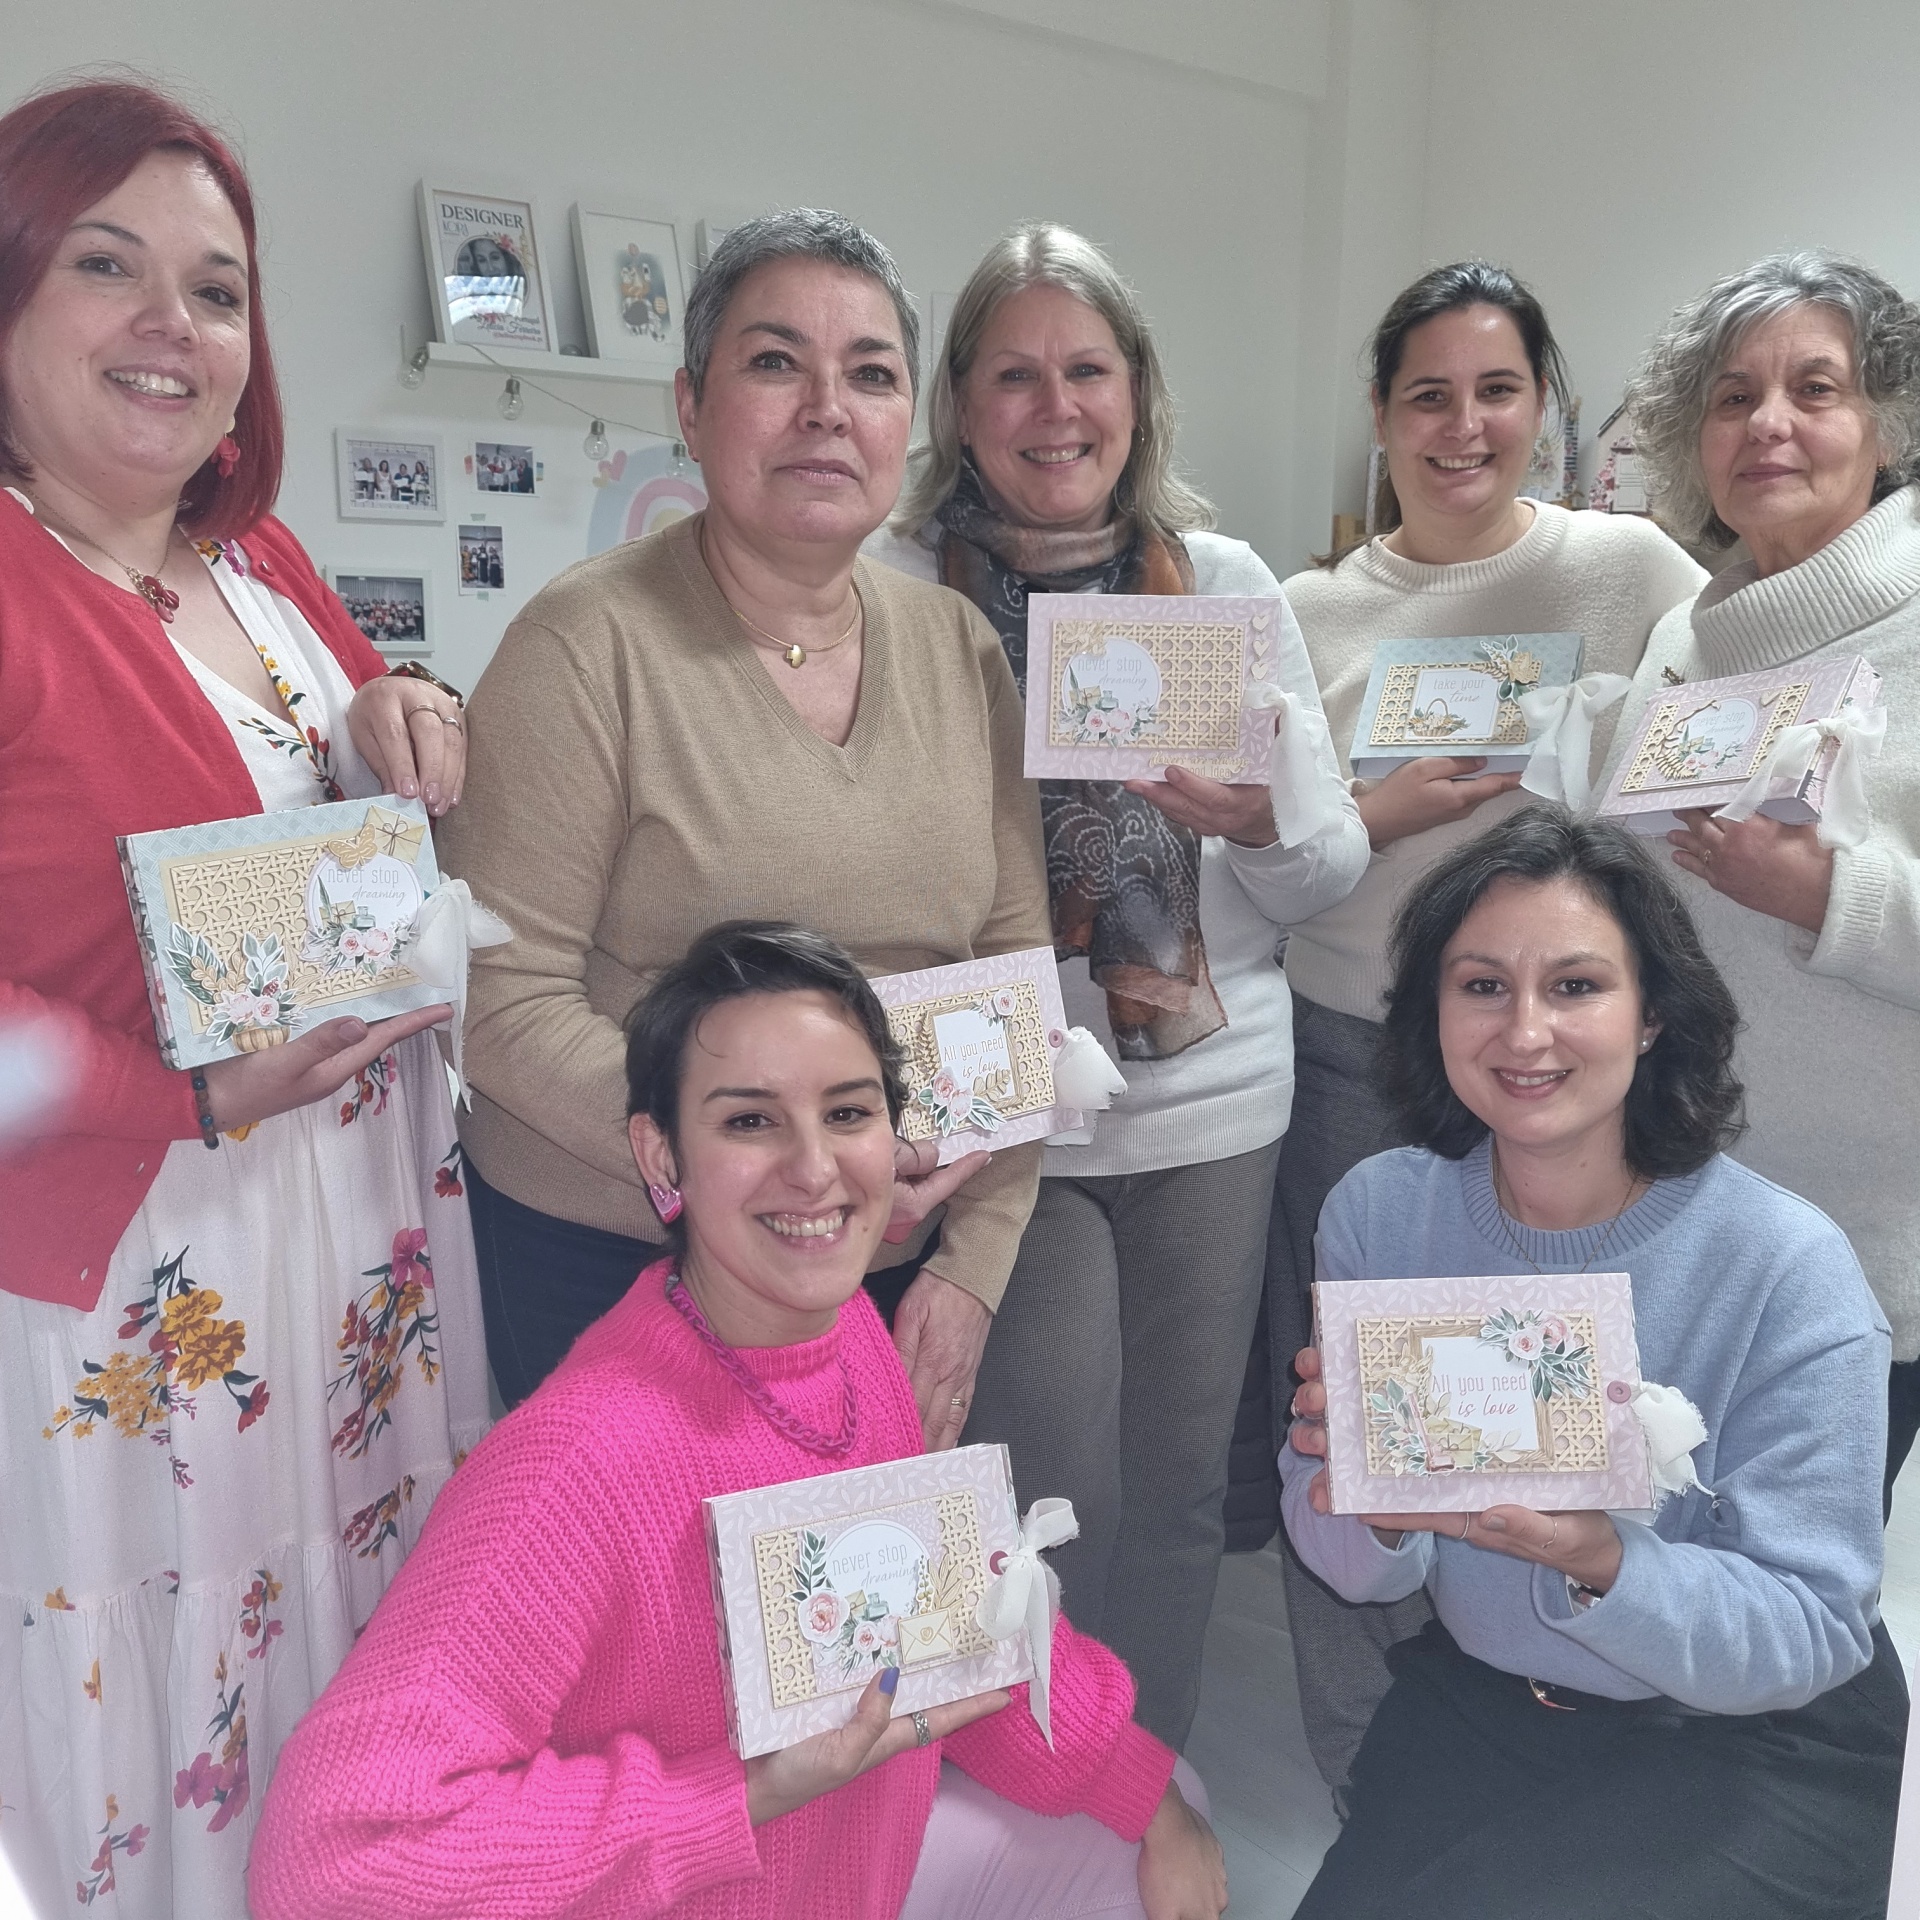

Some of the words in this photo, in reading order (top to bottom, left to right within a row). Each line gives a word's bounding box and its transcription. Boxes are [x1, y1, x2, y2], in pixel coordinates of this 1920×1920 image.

[441, 203, 525, 230] DESIGNER
[1077, 658, 1110, 672] never
[1116, 656, 1142, 676] stop
[1098, 673, 1147, 691] dreaming
[1433, 679, 1457, 690] take
[1461, 679, 1486, 692] your
[1723, 711, 1746, 724] stop
[1210, 765, 1231, 778] idea
[327, 867, 365, 884] never
[371, 866, 399, 888] stop
[351, 885, 406, 908] dreaming
[944, 1045, 957, 1062] All
[960, 1043, 978, 1061] you
[981, 1034, 1004, 1053] need
[962, 1065, 974, 1079] is
[978, 1055, 1000, 1075] love
[1432, 1374, 1451, 1393] All
[1458, 1376, 1484, 1396] you
[1492, 1372, 1527, 1392] need
[1458, 1400, 1476, 1418] is
[1483, 1393, 1519, 1416] love
[832, 1551, 871, 1576] never
[878, 1544, 908, 1565] stop
[861, 1565, 918, 1589] dreaming
